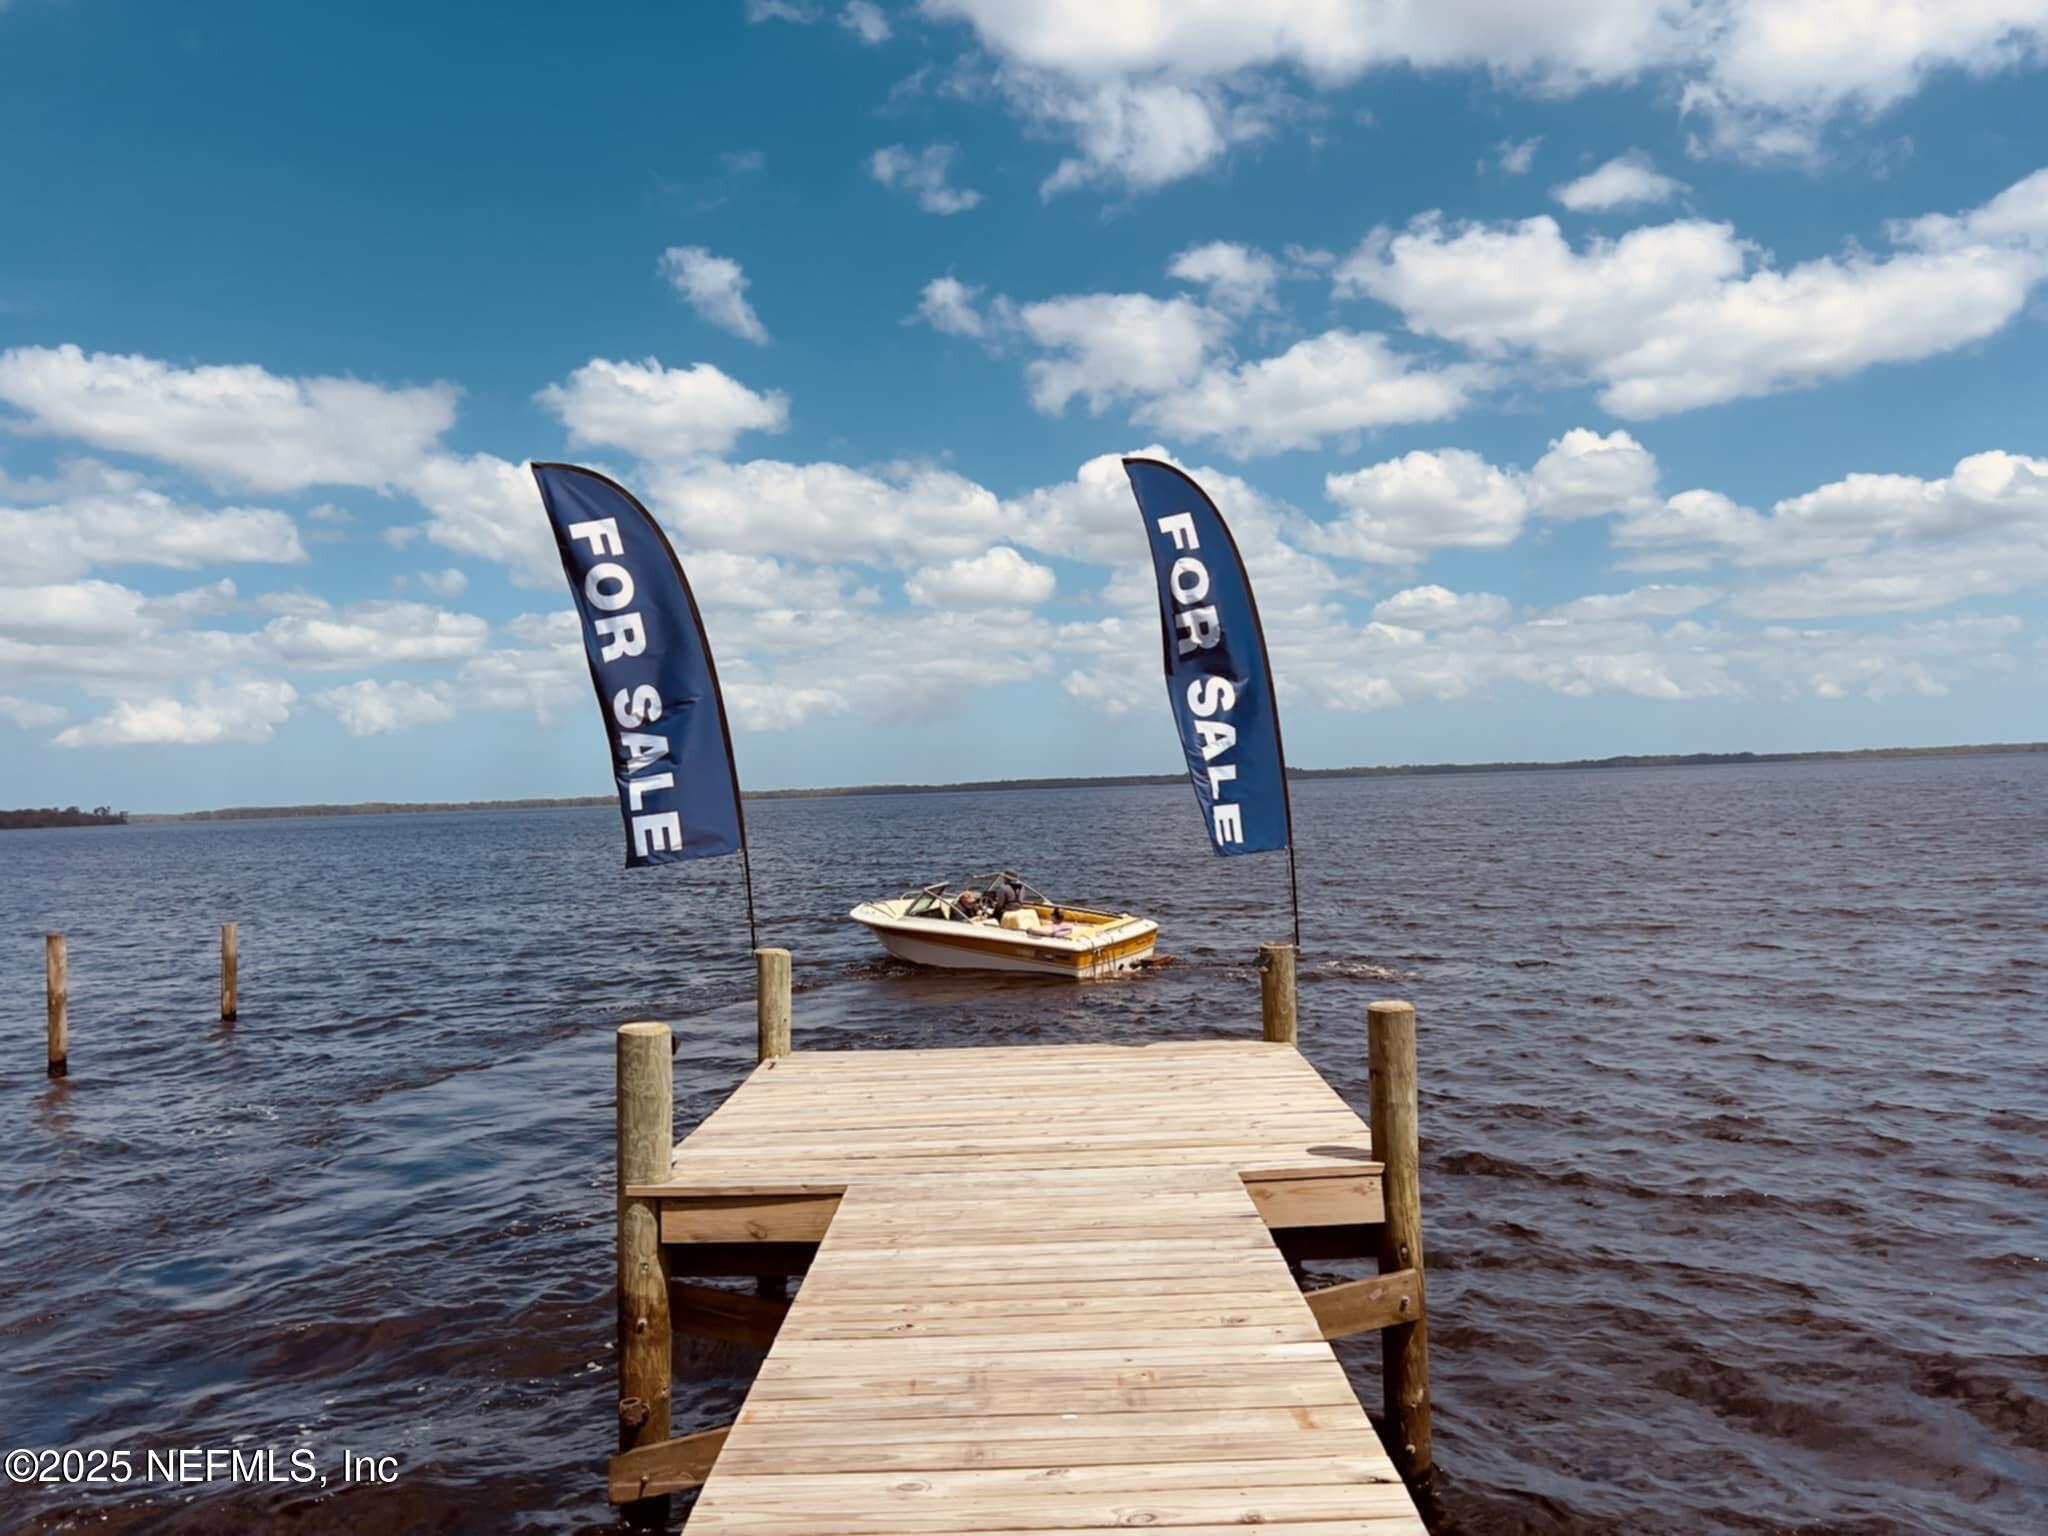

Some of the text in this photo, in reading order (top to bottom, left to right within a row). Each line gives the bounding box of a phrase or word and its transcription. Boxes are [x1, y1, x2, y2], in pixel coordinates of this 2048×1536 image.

[567, 516, 684, 857] FOR SALE
[1157, 511, 1244, 847] FOR SALE
